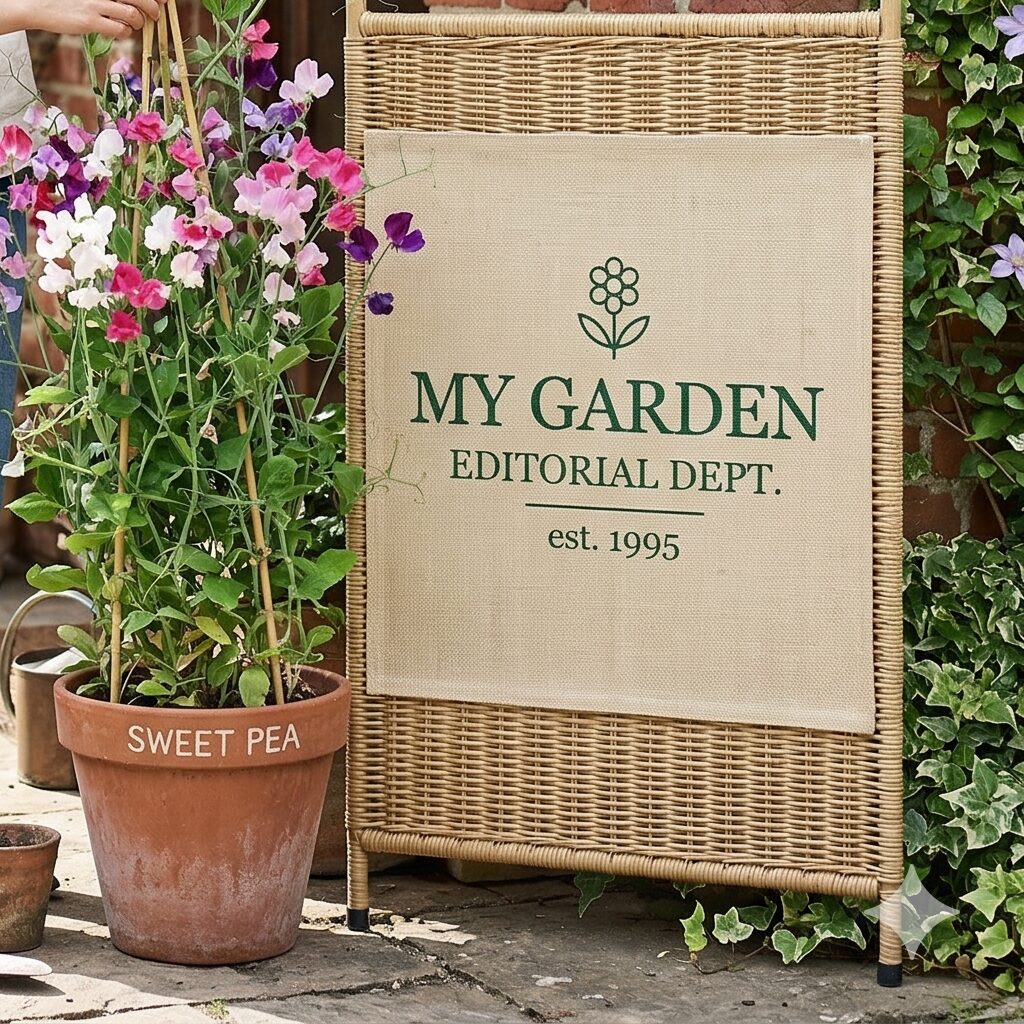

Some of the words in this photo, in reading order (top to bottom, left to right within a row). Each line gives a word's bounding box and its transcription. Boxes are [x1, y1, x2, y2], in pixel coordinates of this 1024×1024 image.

[409, 370, 516, 427] MY
[530, 375, 825, 442] GARDEN
[449, 449, 659, 489] EDITORIAL
[669, 459, 781, 495] DEPT.
[548, 526, 598, 551] est.
[609, 530, 680, 561] 1995
[127, 725, 235, 757] SWEET
[247, 723, 301, 756] PEA
